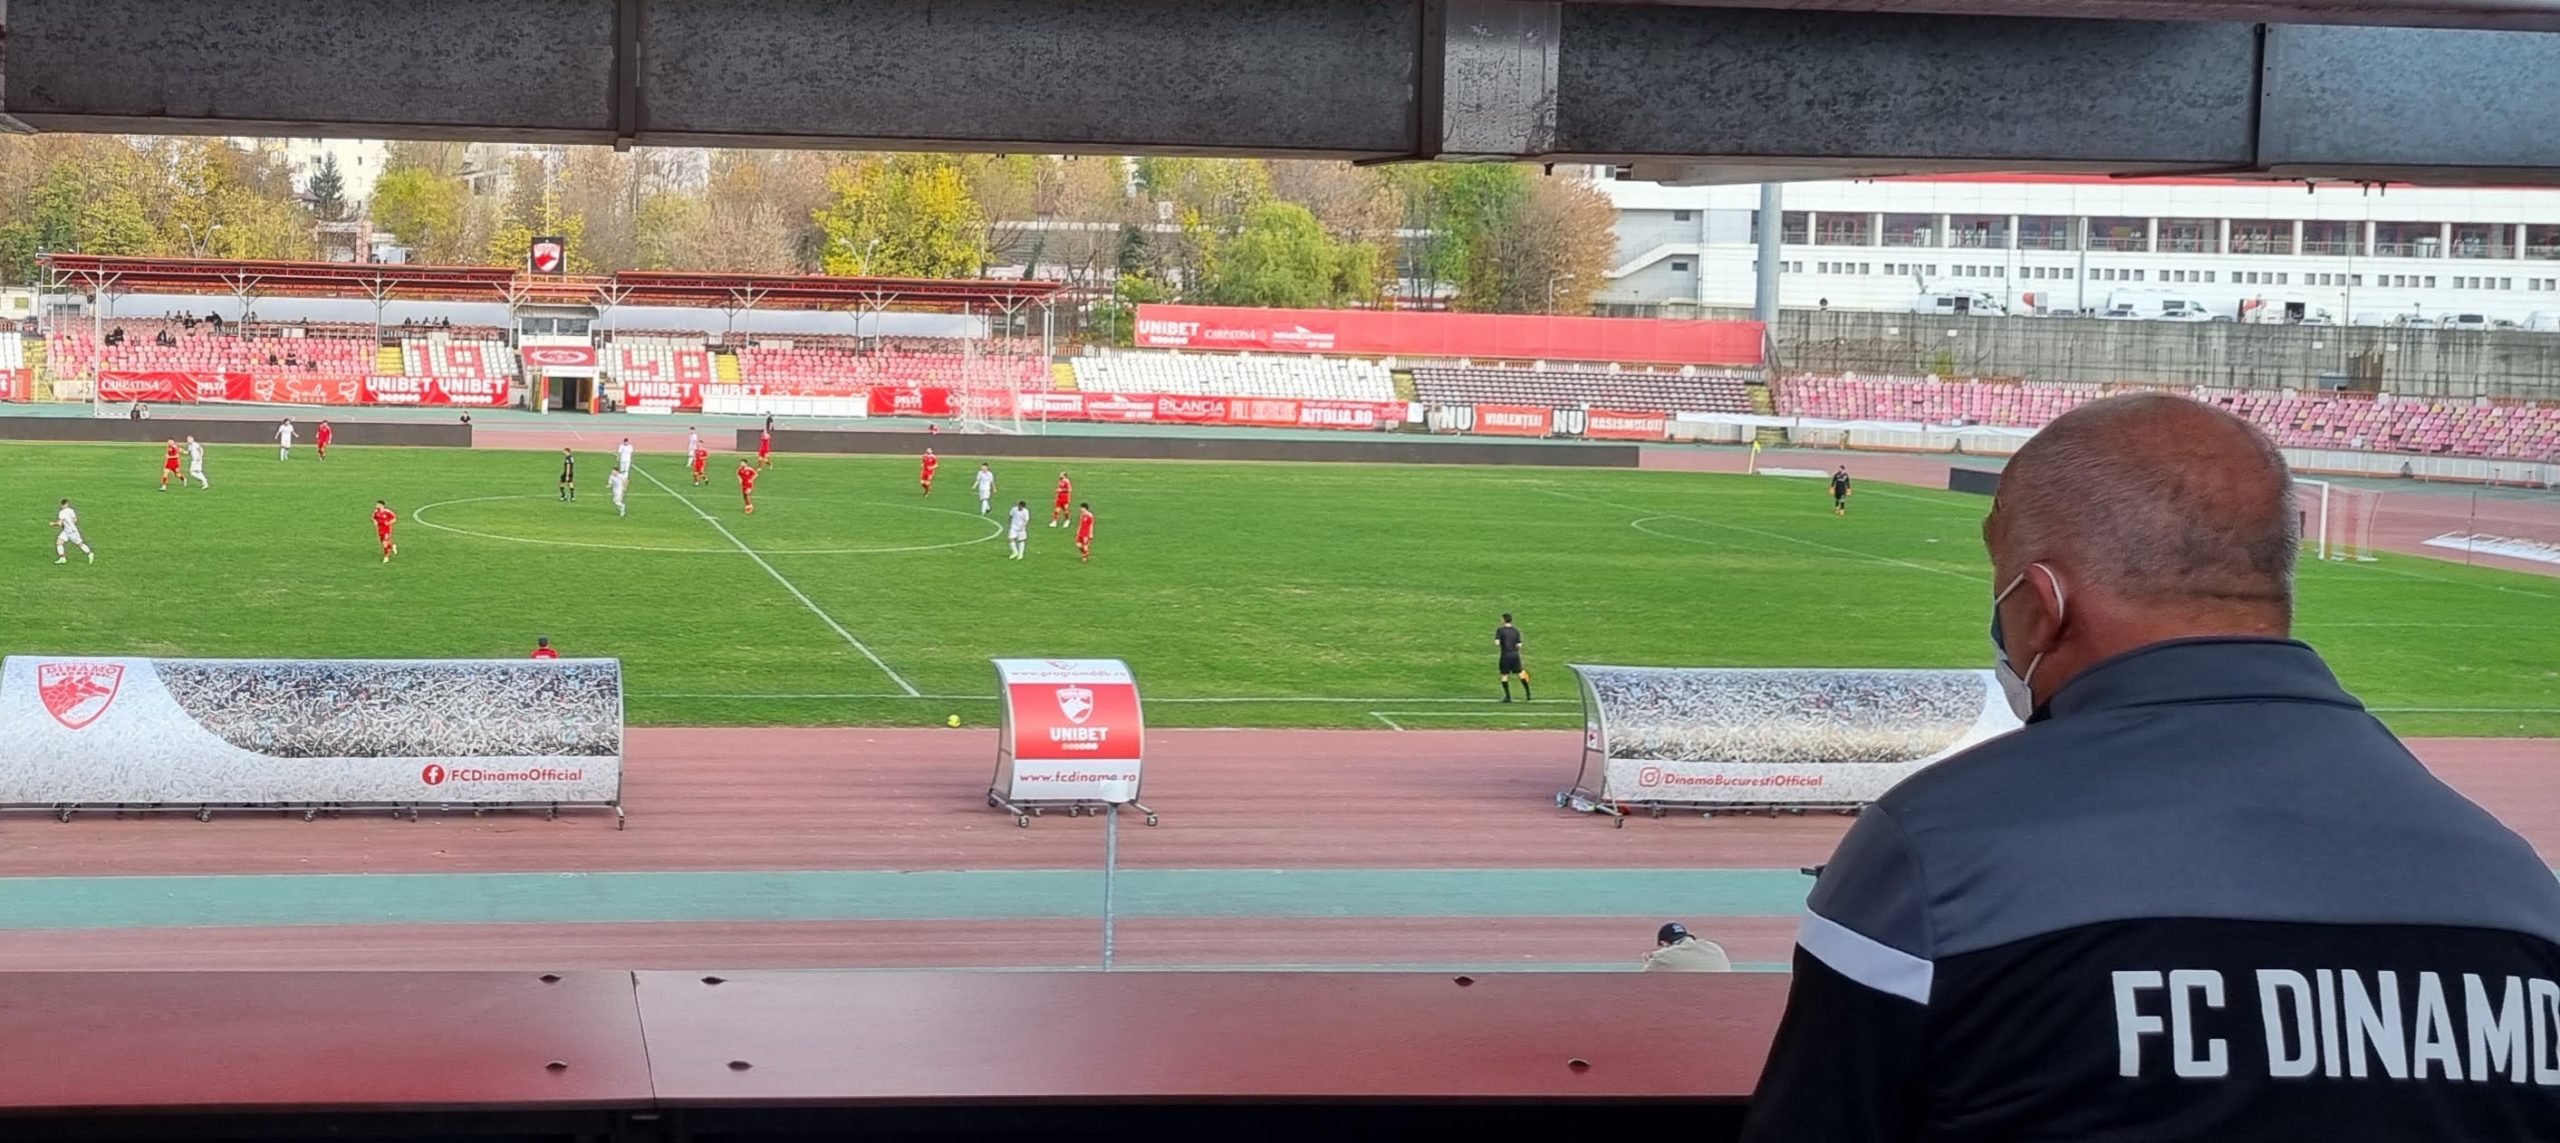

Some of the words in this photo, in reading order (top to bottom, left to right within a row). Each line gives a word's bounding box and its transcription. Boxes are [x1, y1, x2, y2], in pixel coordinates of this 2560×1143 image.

[1139, 320, 1200, 336] UNIBET
[365, 378, 432, 392] UNIBET
[439, 378, 505, 394] UNIBET
[627, 382, 692, 397] UNIBET
[699, 384, 764, 396] UNIBET
[1035, 400, 1082, 412] Baumit
[1158, 399, 1225, 412] BILANCIA
[1441, 406, 1472, 430] NU
[1553, 410, 1584, 434] NU
[46, 665, 117, 674] DINAMO
[1050, 727, 1108, 741] UNIBET
[1020, 772, 1136, 782] www.fcdinamoro
[2112, 969, 2229, 1078] FC
